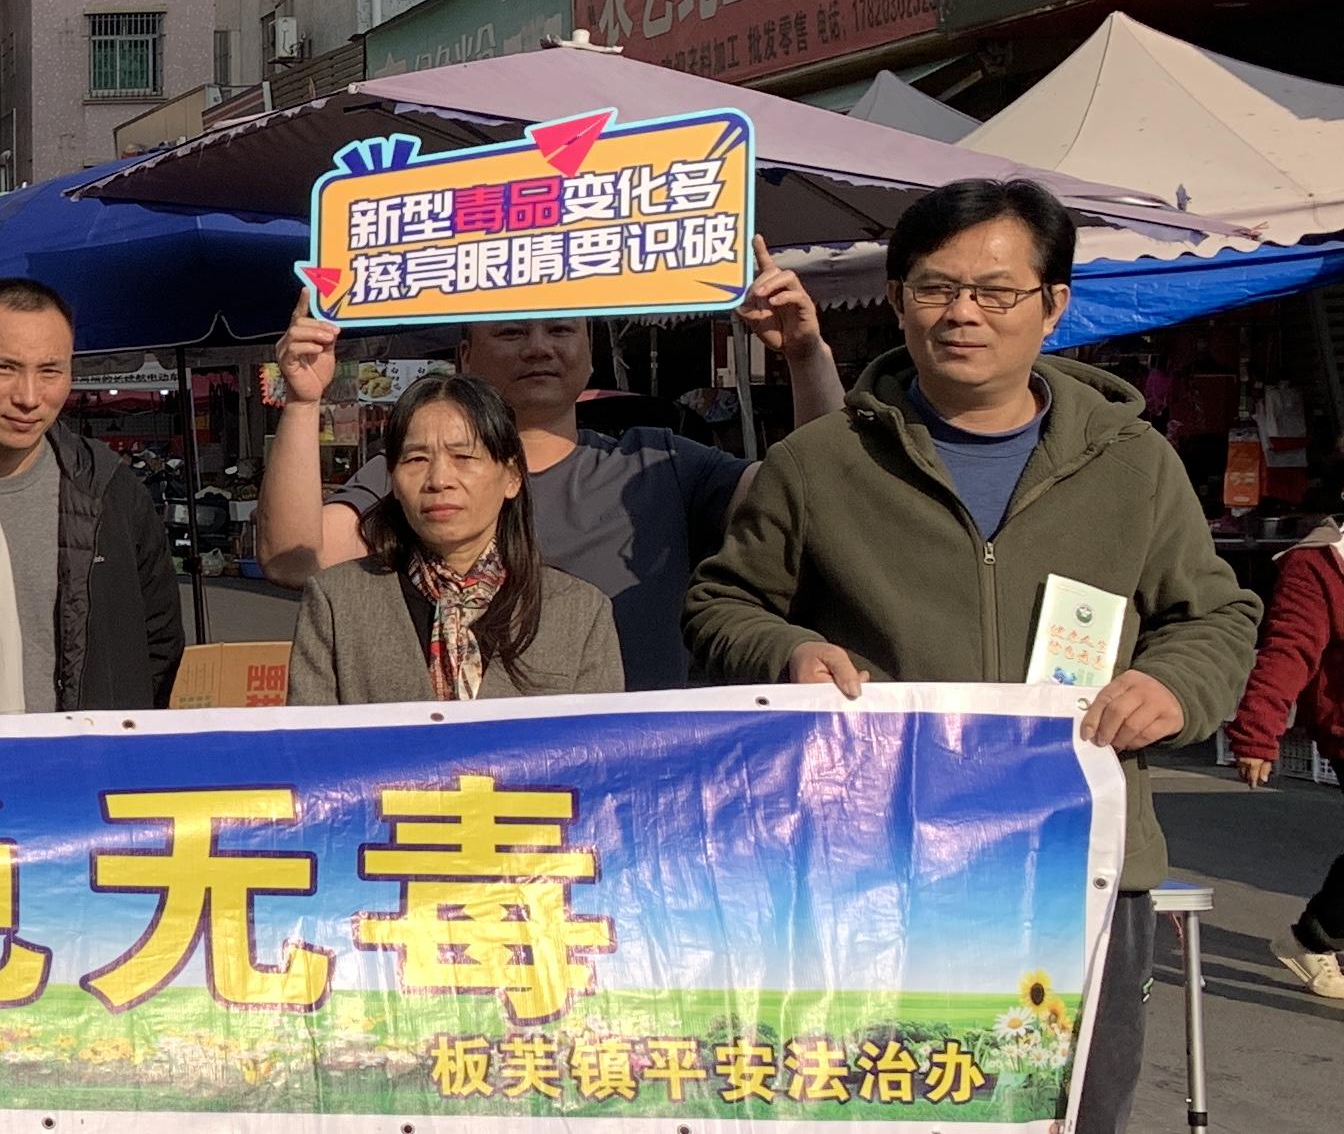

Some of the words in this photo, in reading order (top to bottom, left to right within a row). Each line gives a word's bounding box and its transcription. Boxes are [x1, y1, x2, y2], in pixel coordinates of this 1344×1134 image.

[348, 158, 726, 251] 新型毒品变化多
[348, 213, 739, 306] 擦亮眼睛要识破
[429, 1031, 987, 1105] 板芙镇平安法治办
